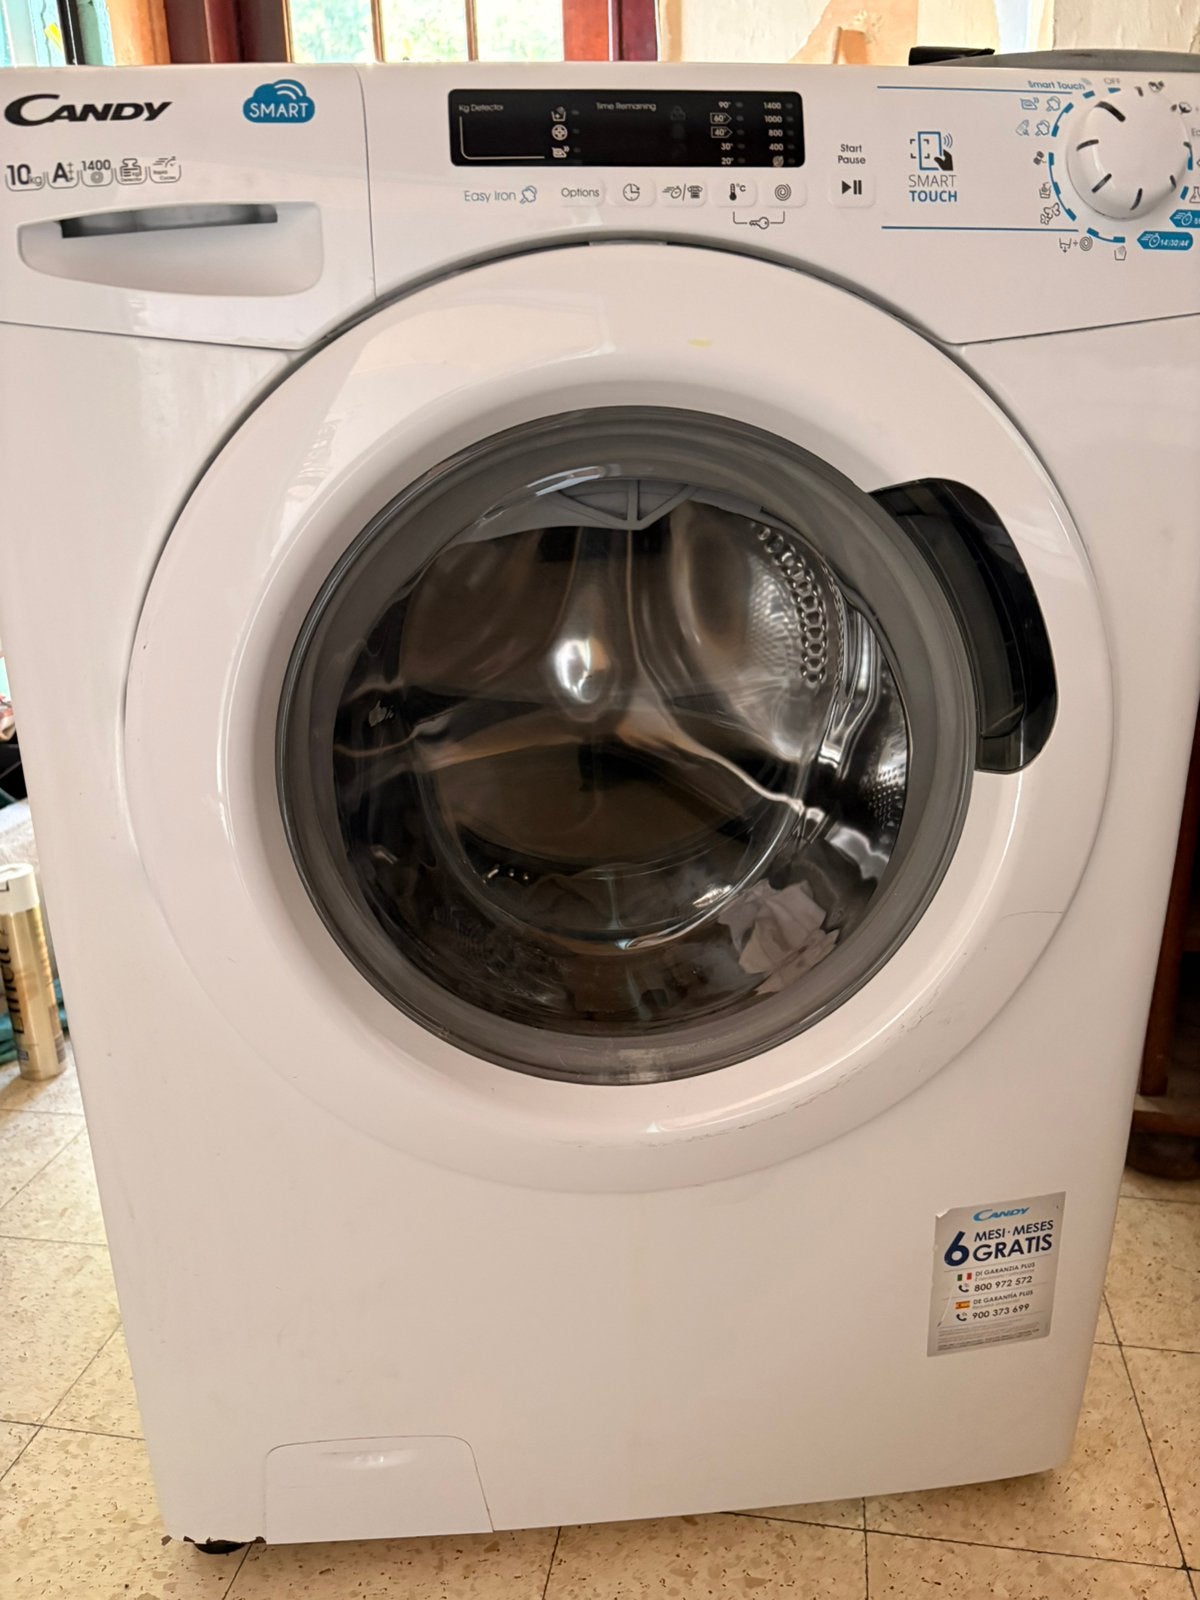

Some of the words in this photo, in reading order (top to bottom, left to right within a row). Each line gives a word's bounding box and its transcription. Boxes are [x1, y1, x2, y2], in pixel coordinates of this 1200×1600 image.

[1028, 80, 1055, 89] Smart
[1058, 80, 1085, 90] Touch
[249, 102, 309, 118] SMART
[471, 104, 504, 112] Detector
[596, 102, 614, 110] Time
[616, 102, 657, 112] Remaining
[764, 115, 782, 123] 1000
[768, 129, 783, 137] 800
[840, 144, 862, 153] Start
[82, 159, 111, 171] 1400
[838, 155, 866, 164] Pause
[908, 174, 957, 188] SMART
[464, 190, 491, 203] Easy
[495, 190, 516, 201] Iron
[561, 187, 600, 199] Options
[909, 190, 958, 202] TOUCH
[1012, 1220, 1054, 1236] MESES
[944, 1230, 970, 1267] 6
[973, 1233, 1053, 1262] GRATIS
[984, 1265, 1019, 1275] GARANZIA
[974, 1282, 992, 1292] 800
[995, 1279, 1013, 1288] 972
[1015, 1275, 1033, 1286] 572
[972, 1310, 990, 1319] 900
[992, 1307, 1010, 1317] 373
[1012, 1303, 1030, 1313] 699
